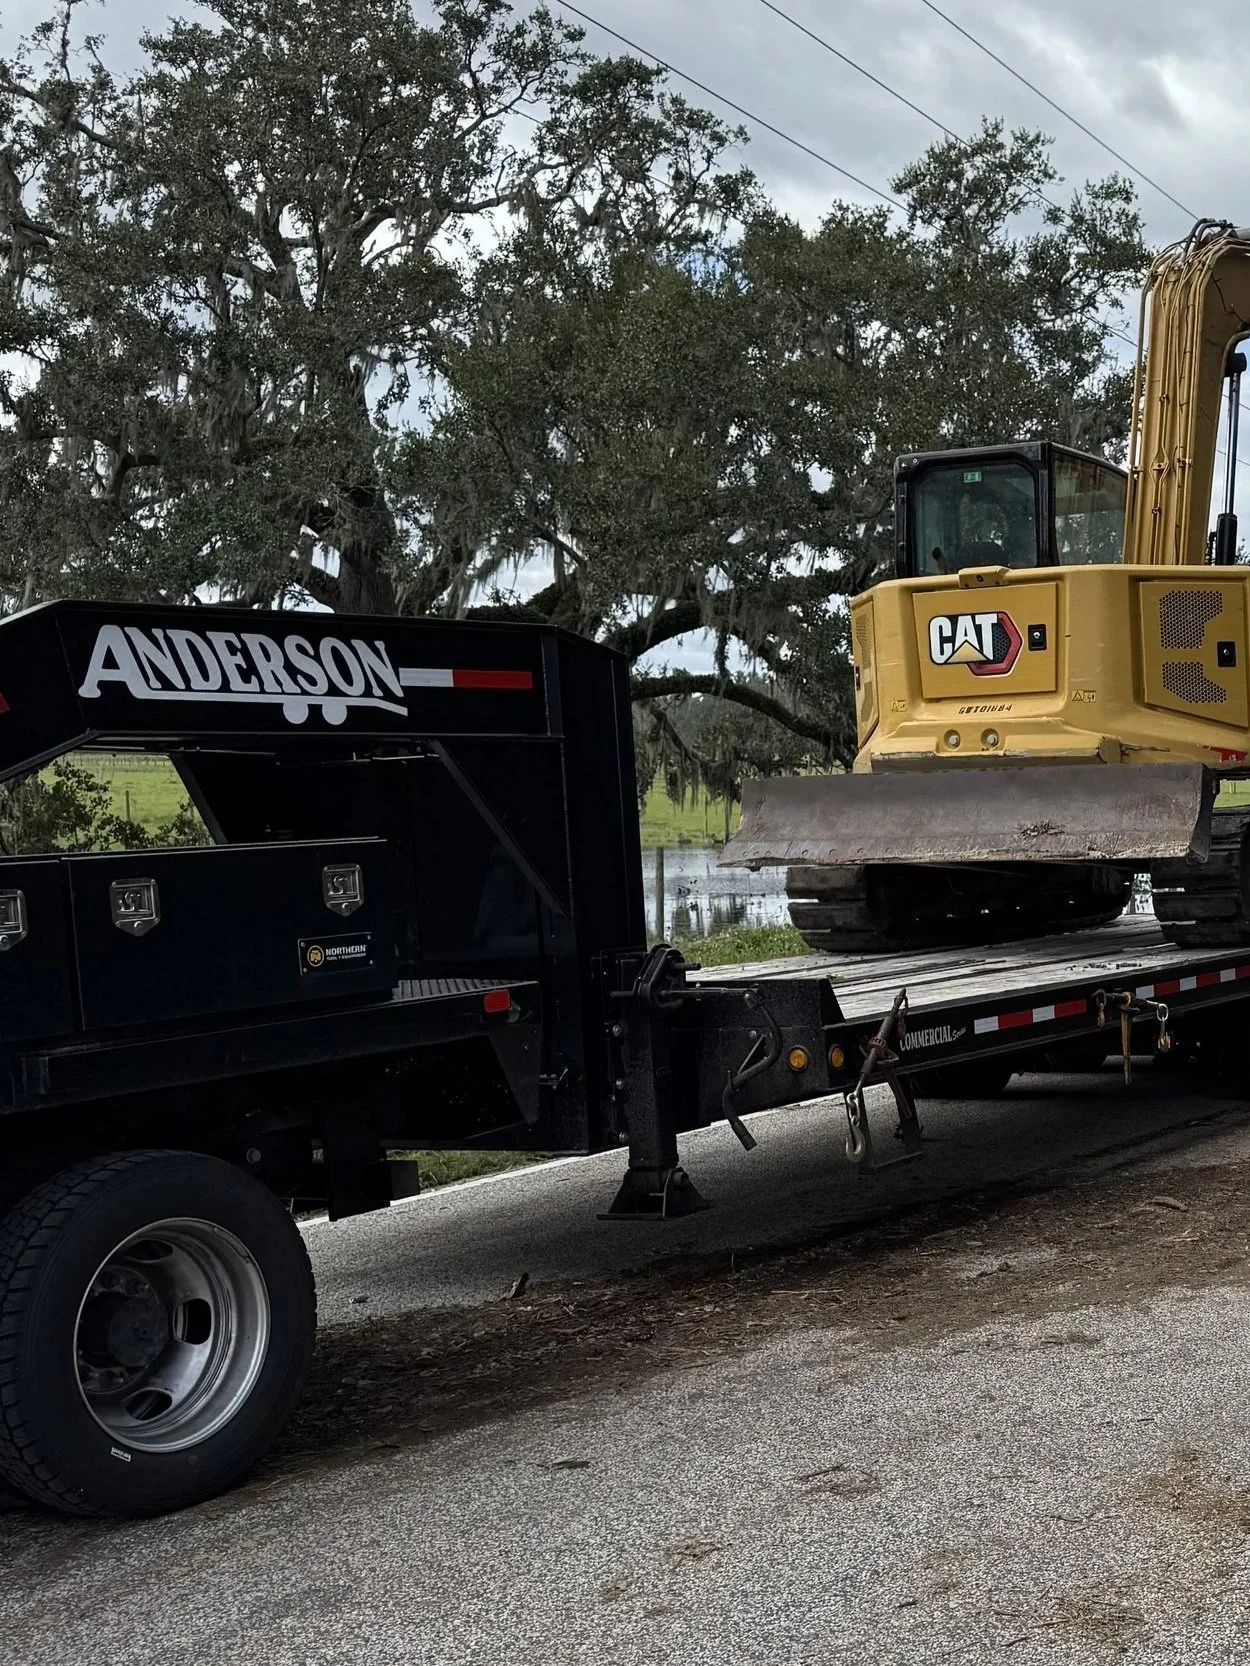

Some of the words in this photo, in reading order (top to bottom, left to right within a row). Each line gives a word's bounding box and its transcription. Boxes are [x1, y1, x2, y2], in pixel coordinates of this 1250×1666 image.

[78, 624, 404, 698] ANDERSON
[930, 612, 998, 664] CAT
[326, 945, 367, 956] NORTHERN
